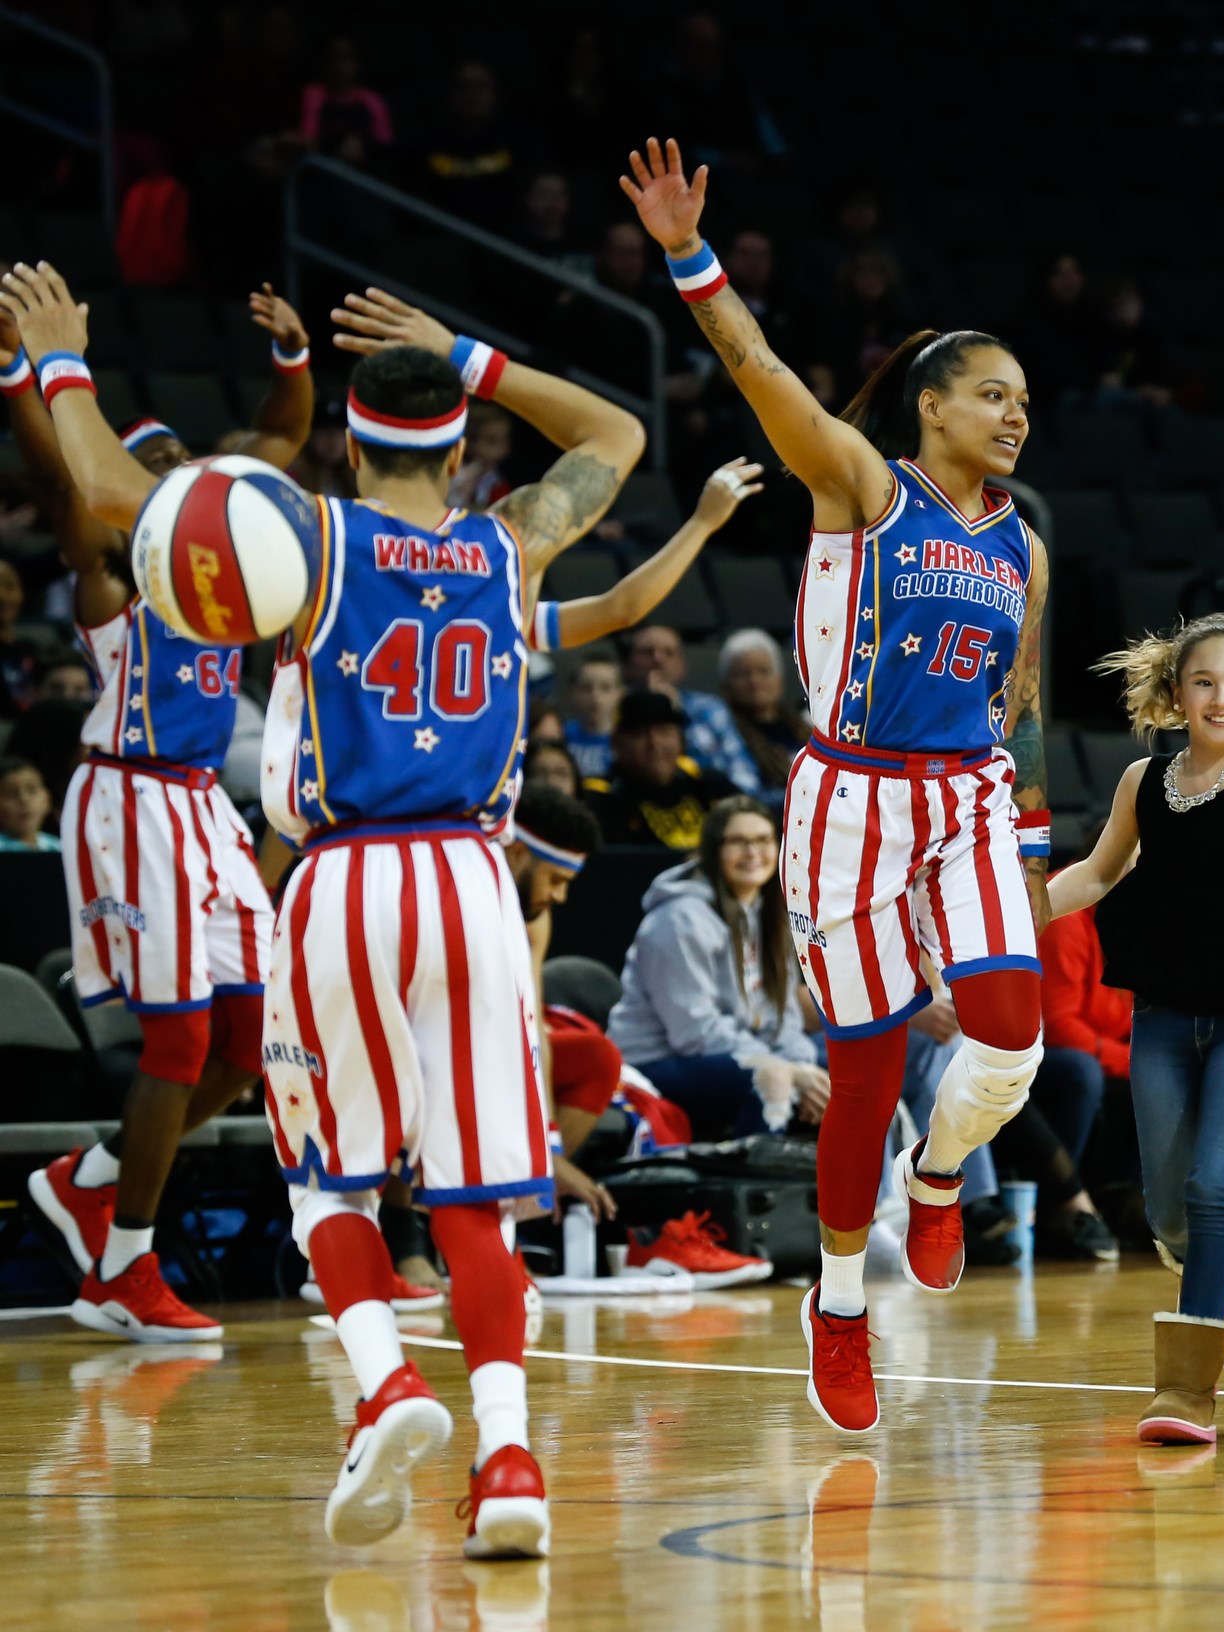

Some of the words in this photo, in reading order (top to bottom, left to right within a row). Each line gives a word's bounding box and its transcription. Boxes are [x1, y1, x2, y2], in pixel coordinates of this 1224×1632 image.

[373, 534, 492, 577] WHAM
[922, 539, 1024, 598] HARLEM
[893, 572, 1025, 630] GLOBETROTTER
[361, 617, 492, 721] 40
[926, 621, 993, 682] 15
[261, 1042, 322, 1078] ARLEM
